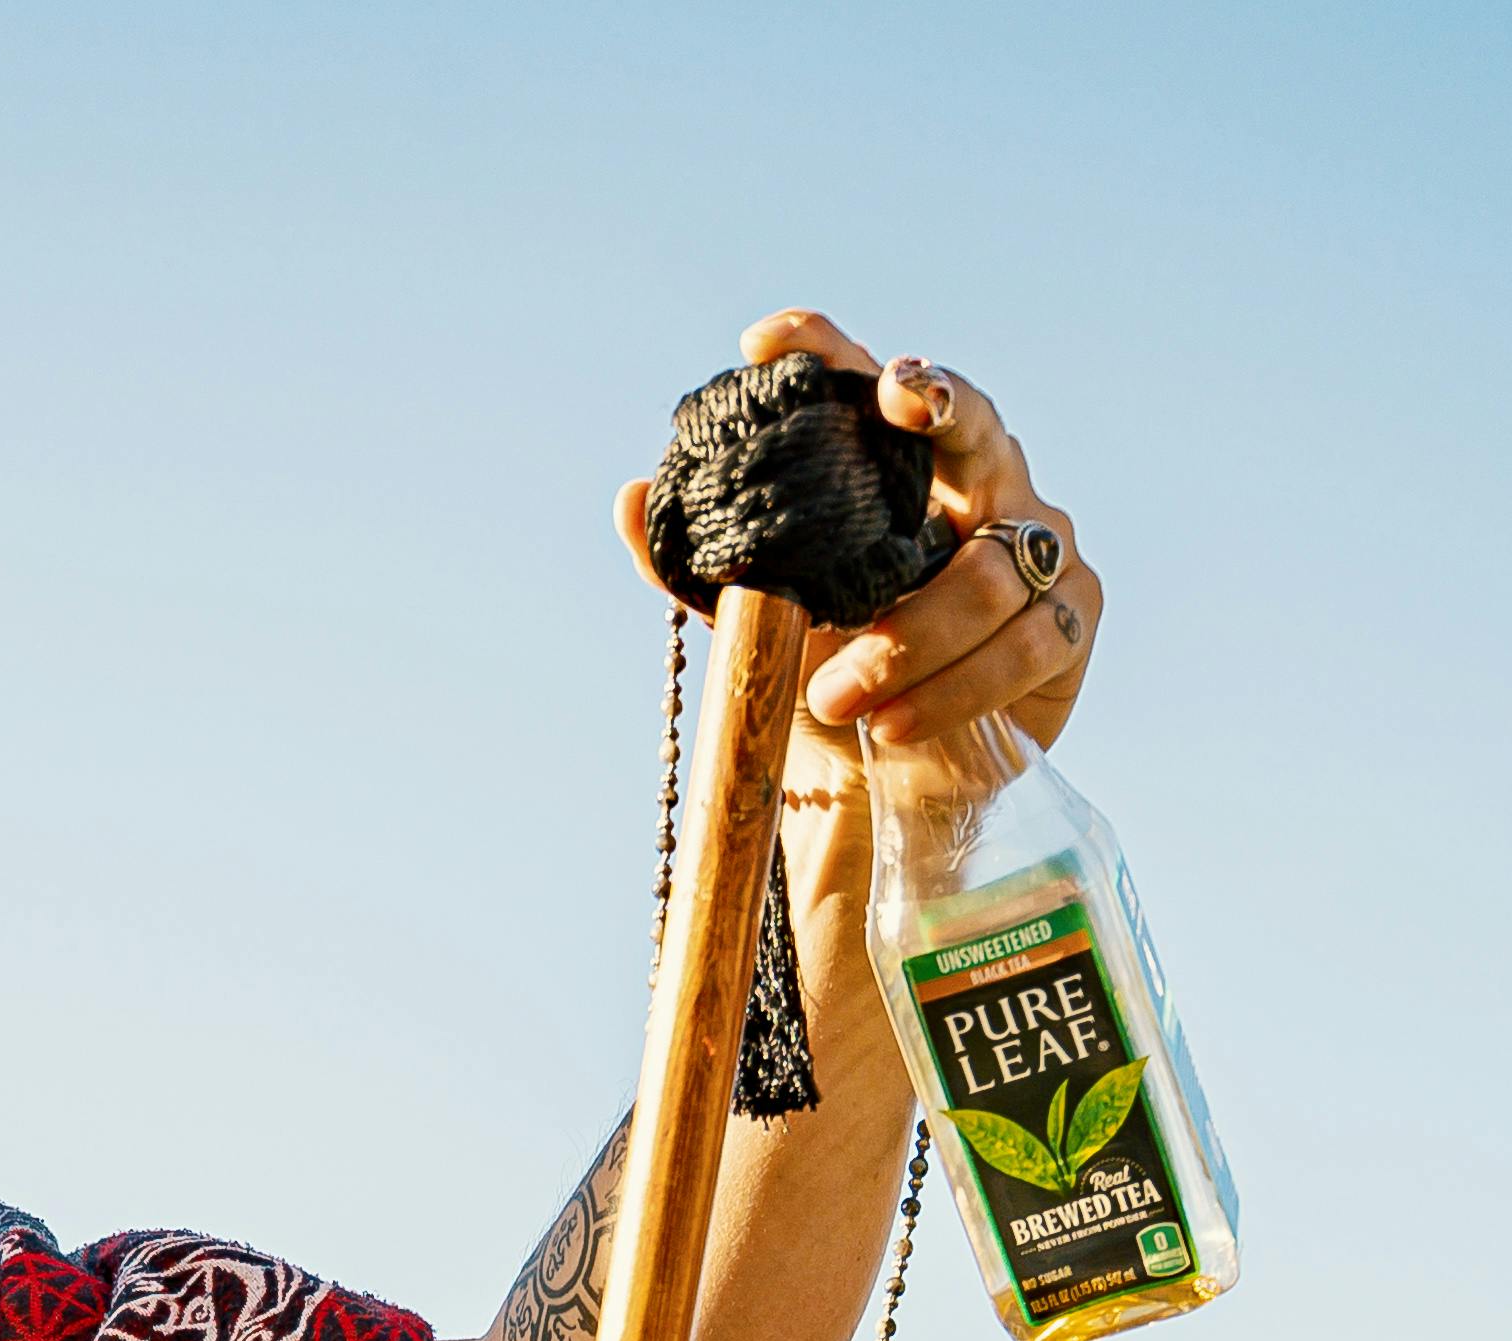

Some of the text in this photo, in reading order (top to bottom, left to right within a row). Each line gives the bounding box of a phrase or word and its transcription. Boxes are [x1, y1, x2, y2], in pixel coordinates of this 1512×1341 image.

[935, 919, 1053, 975] UNSWEETENED
[943, 973, 1093, 1054] PURE
[957, 1015, 1098, 1095] LEAF
[1089, 1164, 1132, 1193] Real
[1009, 1178, 1163, 1246] BREWED TEA
[1153, 1231, 1169, 1251] 0
